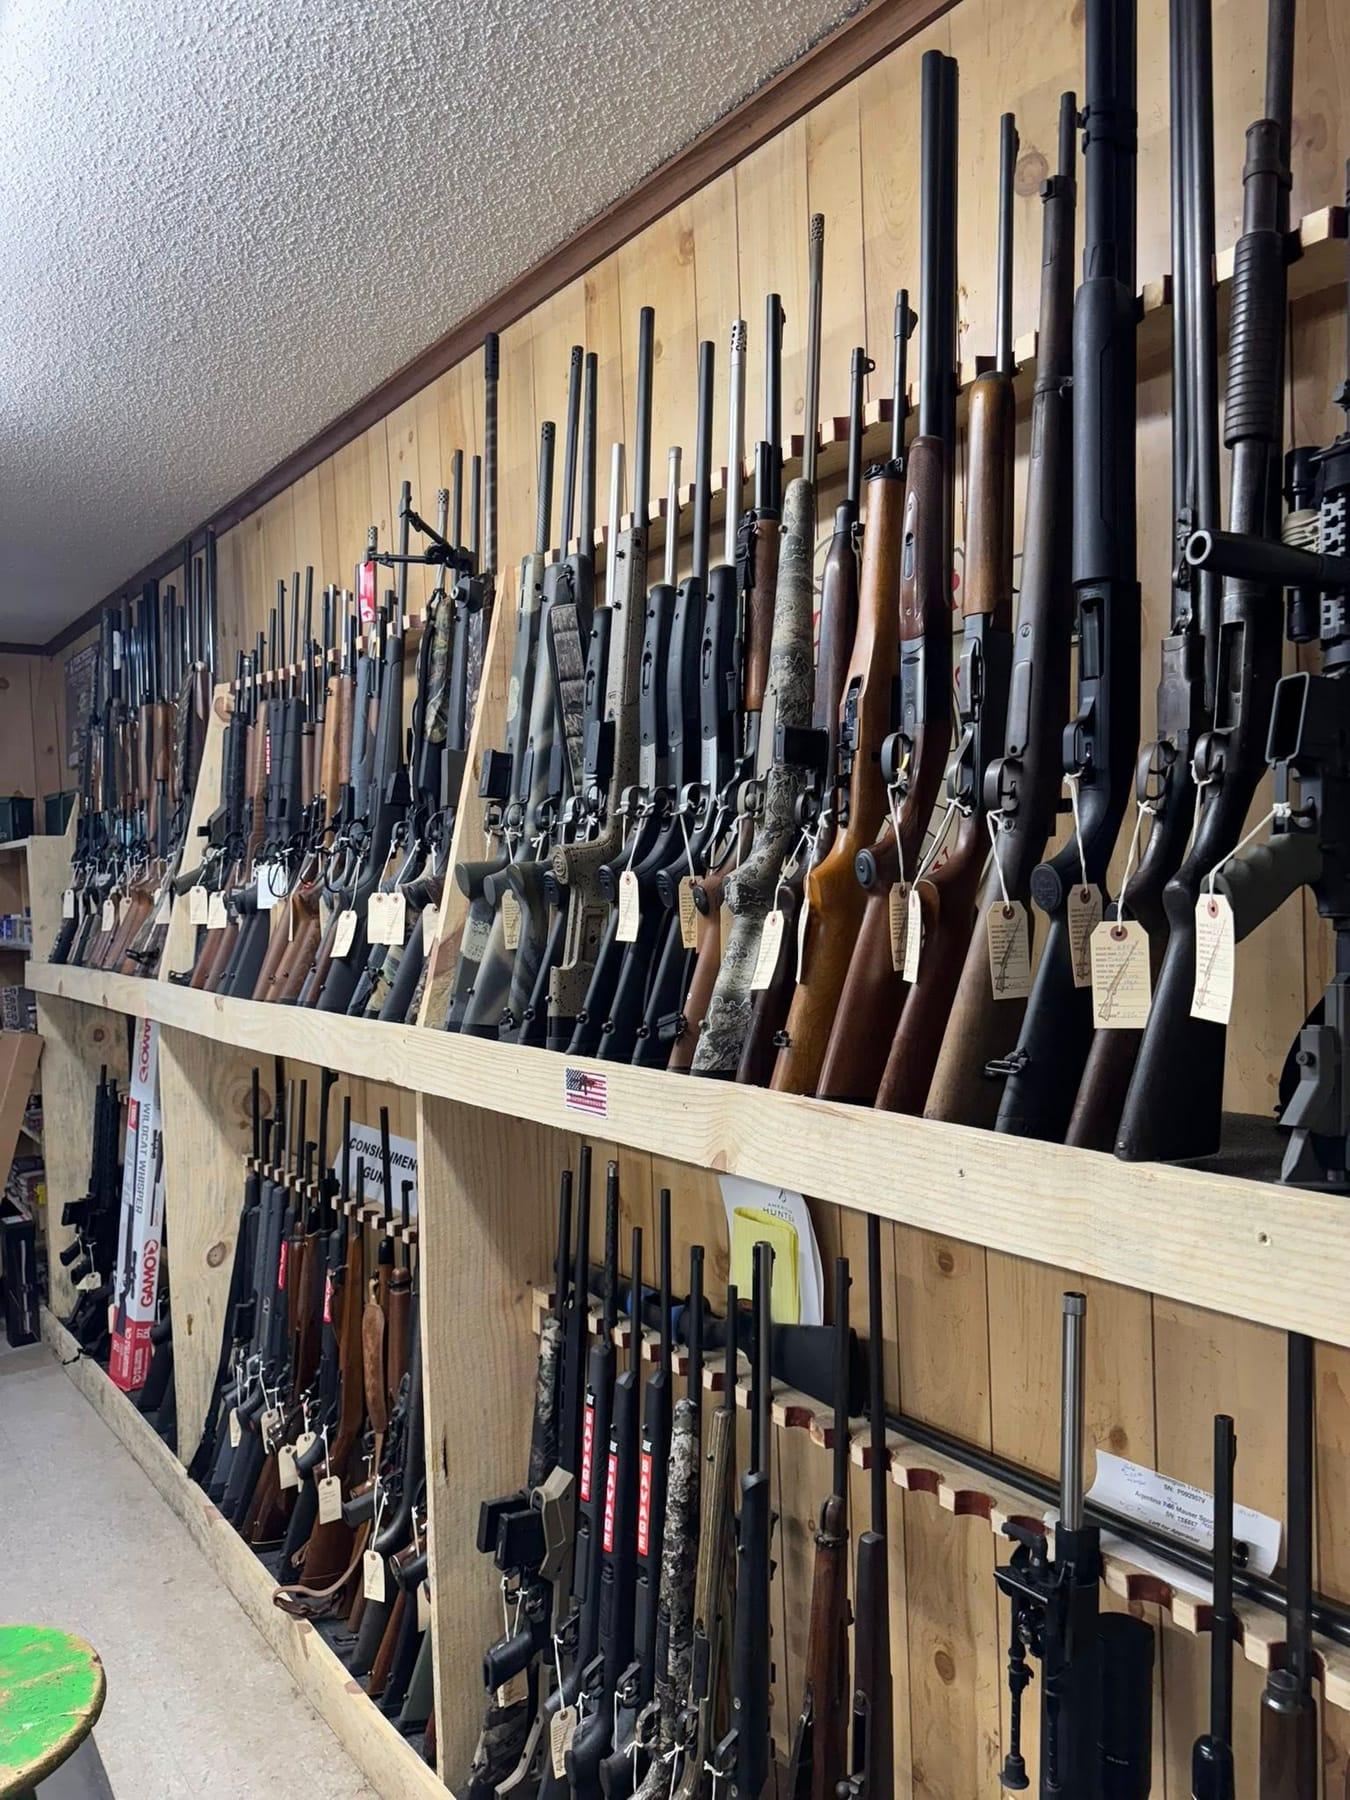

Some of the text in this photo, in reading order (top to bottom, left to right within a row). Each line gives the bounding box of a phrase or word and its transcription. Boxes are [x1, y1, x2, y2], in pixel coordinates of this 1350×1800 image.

[141, 1018, 151, 1065] AMO
[136, 1103, 151, 1215] WILDCAT WHISPER
[349, 1138, 418, 1171] CONSIMEN
[141, 1255, 157, 1307] GAMO
[581, 1411, 592, 1495] SAVAGE
[604, 1460, 615, 1547] SAVAGE
[638, 1459, 650, 1549] SAVAGE
